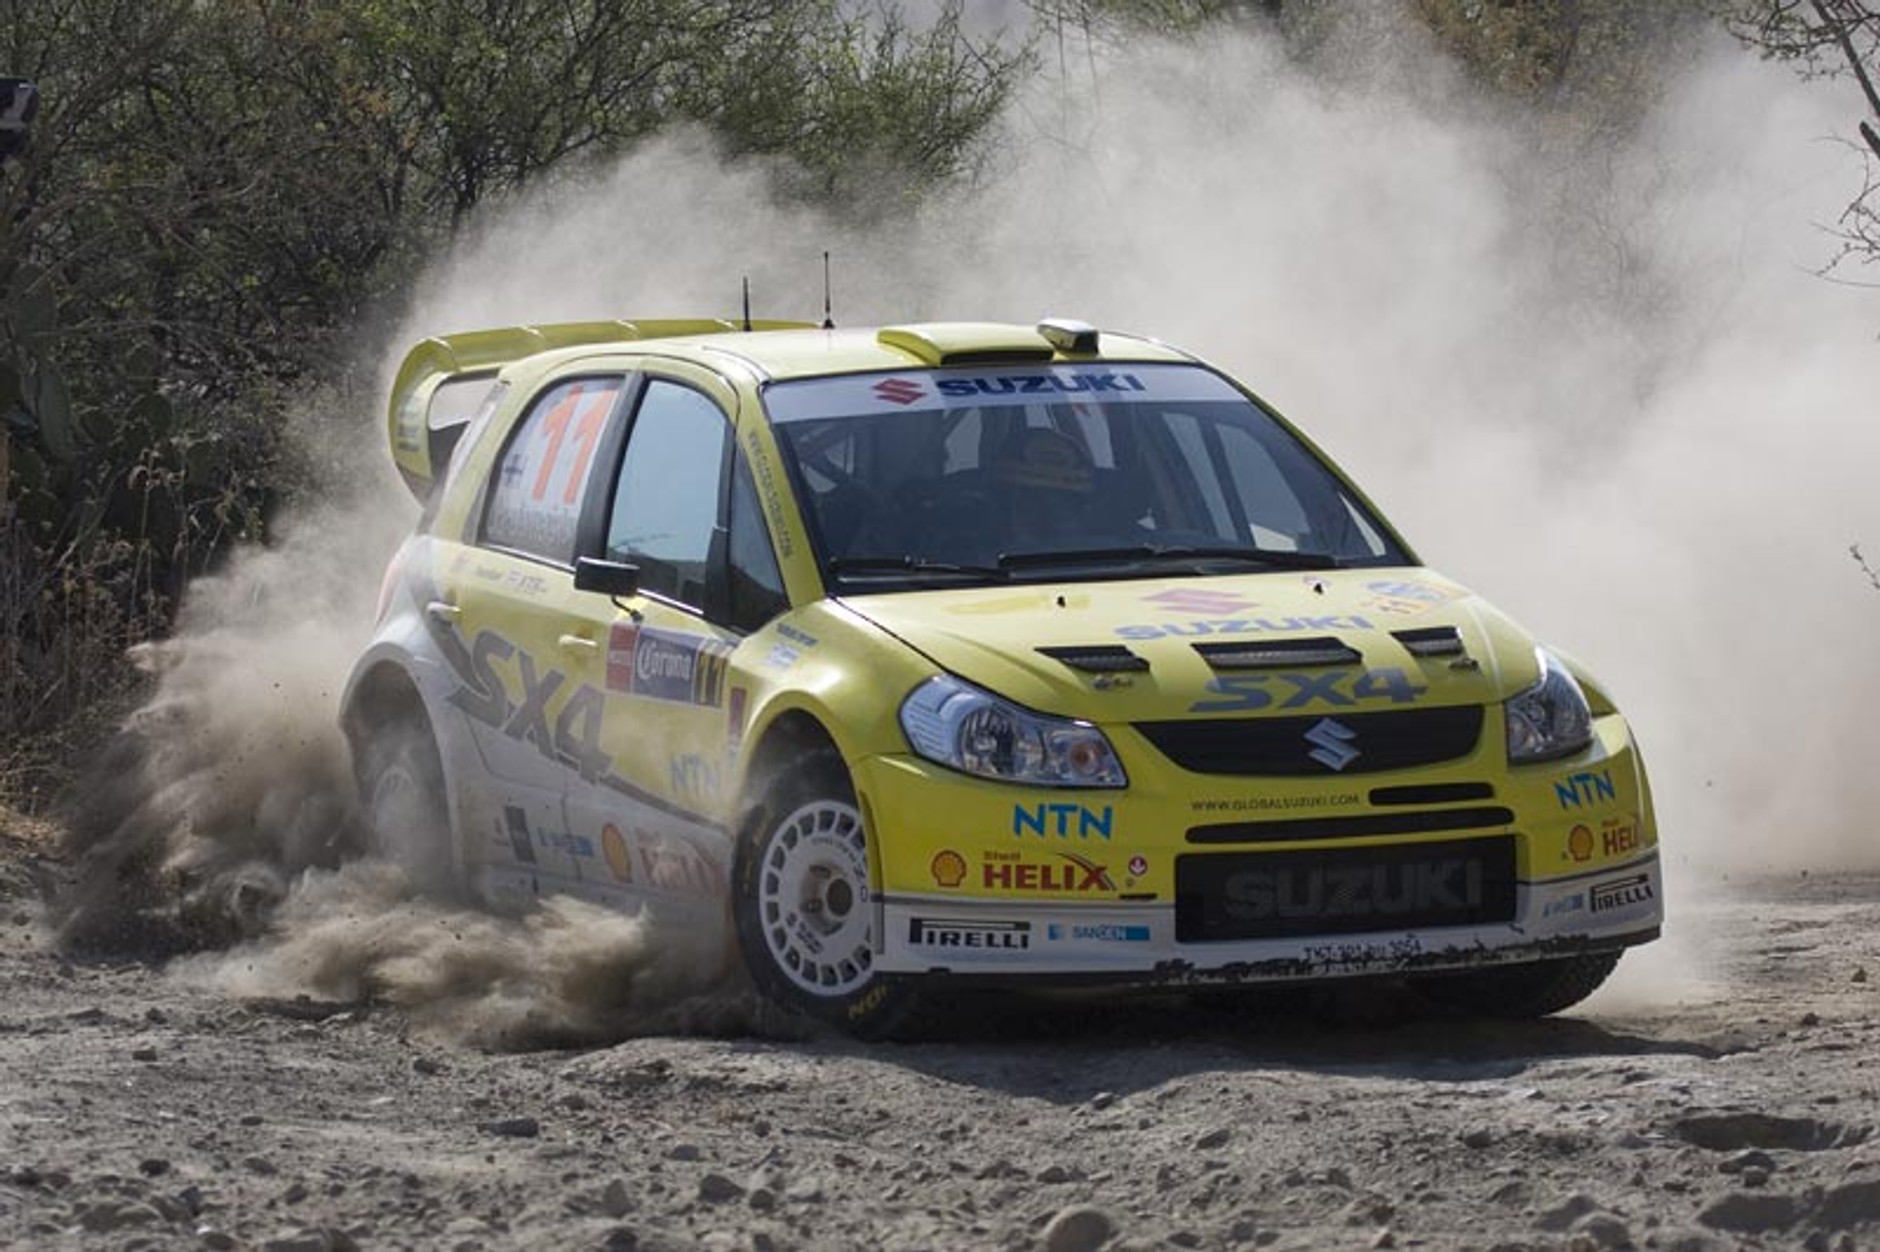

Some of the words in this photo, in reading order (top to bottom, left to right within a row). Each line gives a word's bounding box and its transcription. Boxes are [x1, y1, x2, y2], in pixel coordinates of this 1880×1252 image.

[936, 374, 1146, 397] SUZUKI
[532, 385, 620, 504] 11
[1114, 614, 1374, 641] SUZUKI
[636, 639, 693, 681] Corona
[447, 629, 614, 785] SX4
[1188, 667, 1429, 713] SX4
[1191, 794, 1360, 811] WWW.GLOBALSUZUKI.COM
[1553, 771, 1616, 809] NTN
[1013, 803, 1113, 840] NTN
[982, 860, 1116, 892] HELIX
[1224, 858, 1485, 921] SUZUKI
[1589, 873, 1653, 912] PIRELLI
[909, 917, 1031, 949] PIRELLI
